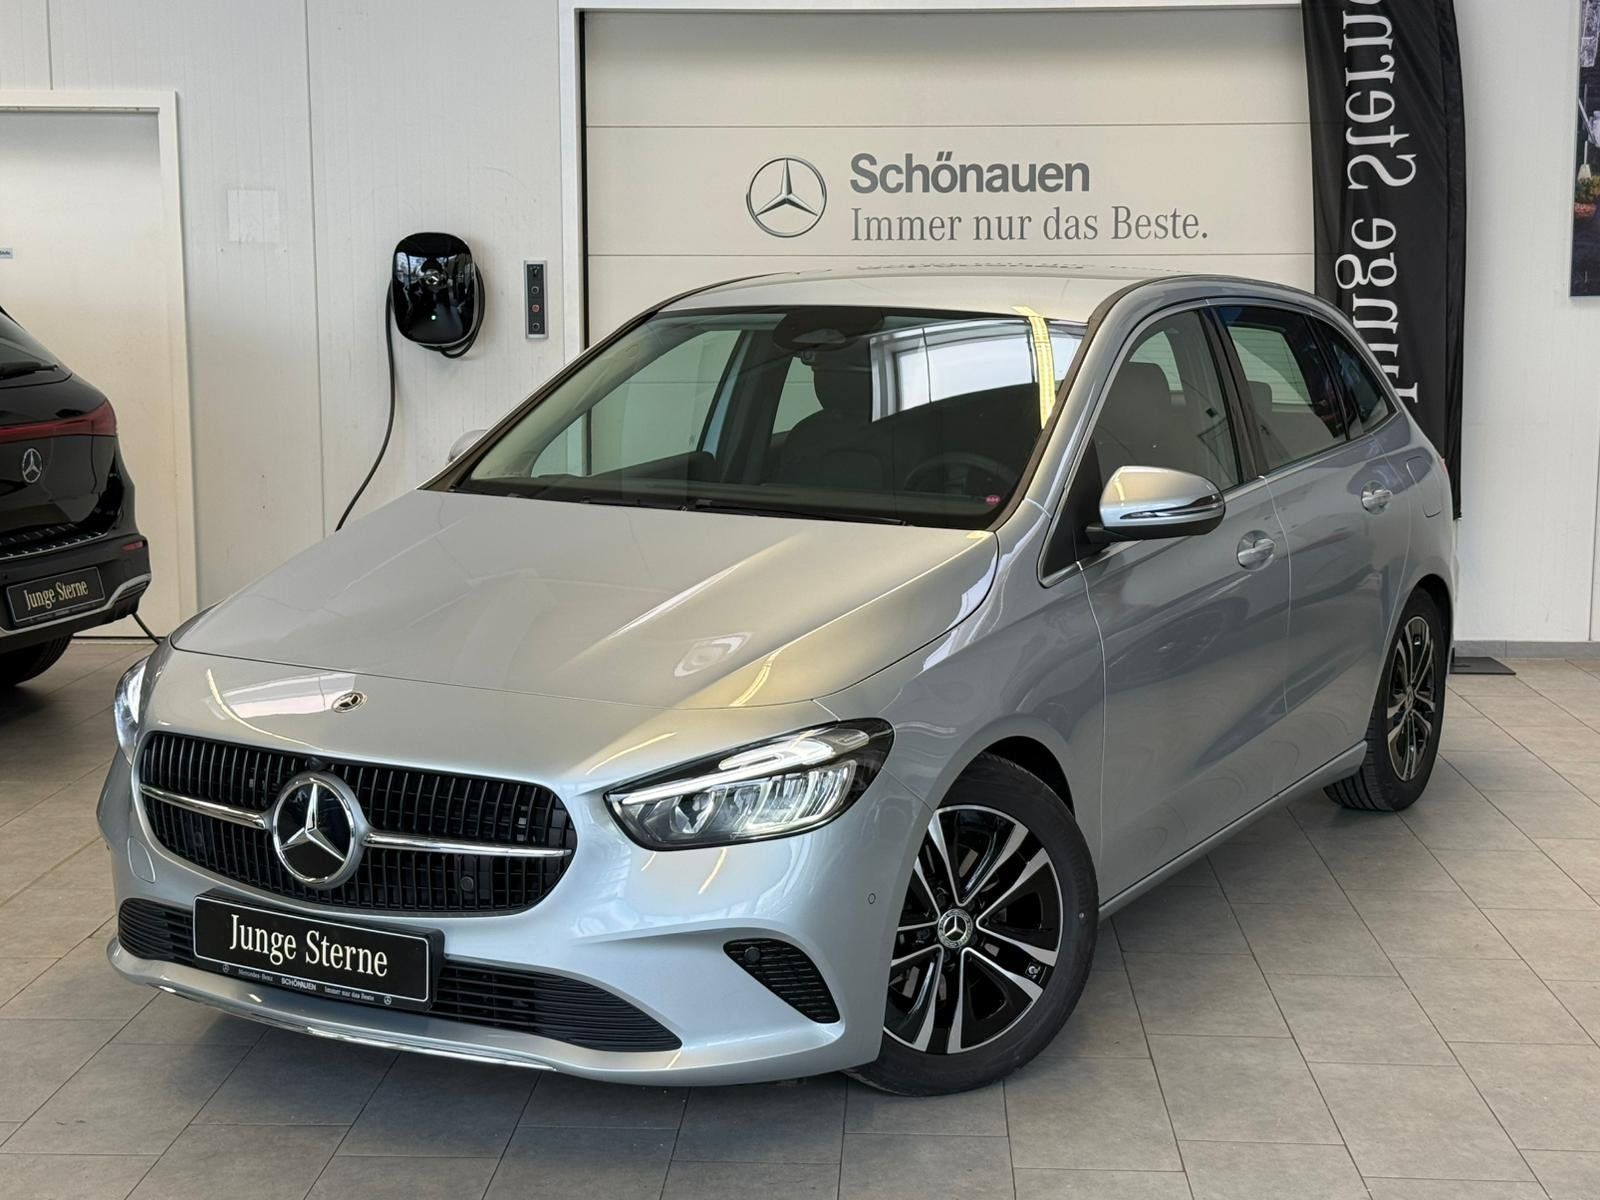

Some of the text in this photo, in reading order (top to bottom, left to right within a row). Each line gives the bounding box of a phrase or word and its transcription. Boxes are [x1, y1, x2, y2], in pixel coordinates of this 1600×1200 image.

[850, 151, 1090, 193] Schönauen
[851, 205, 1208, 241] Immer nur das Beste.
[24, 581, 89, 611] Junge Sterne
[230, 914, 388, 977] Junge Sterne
